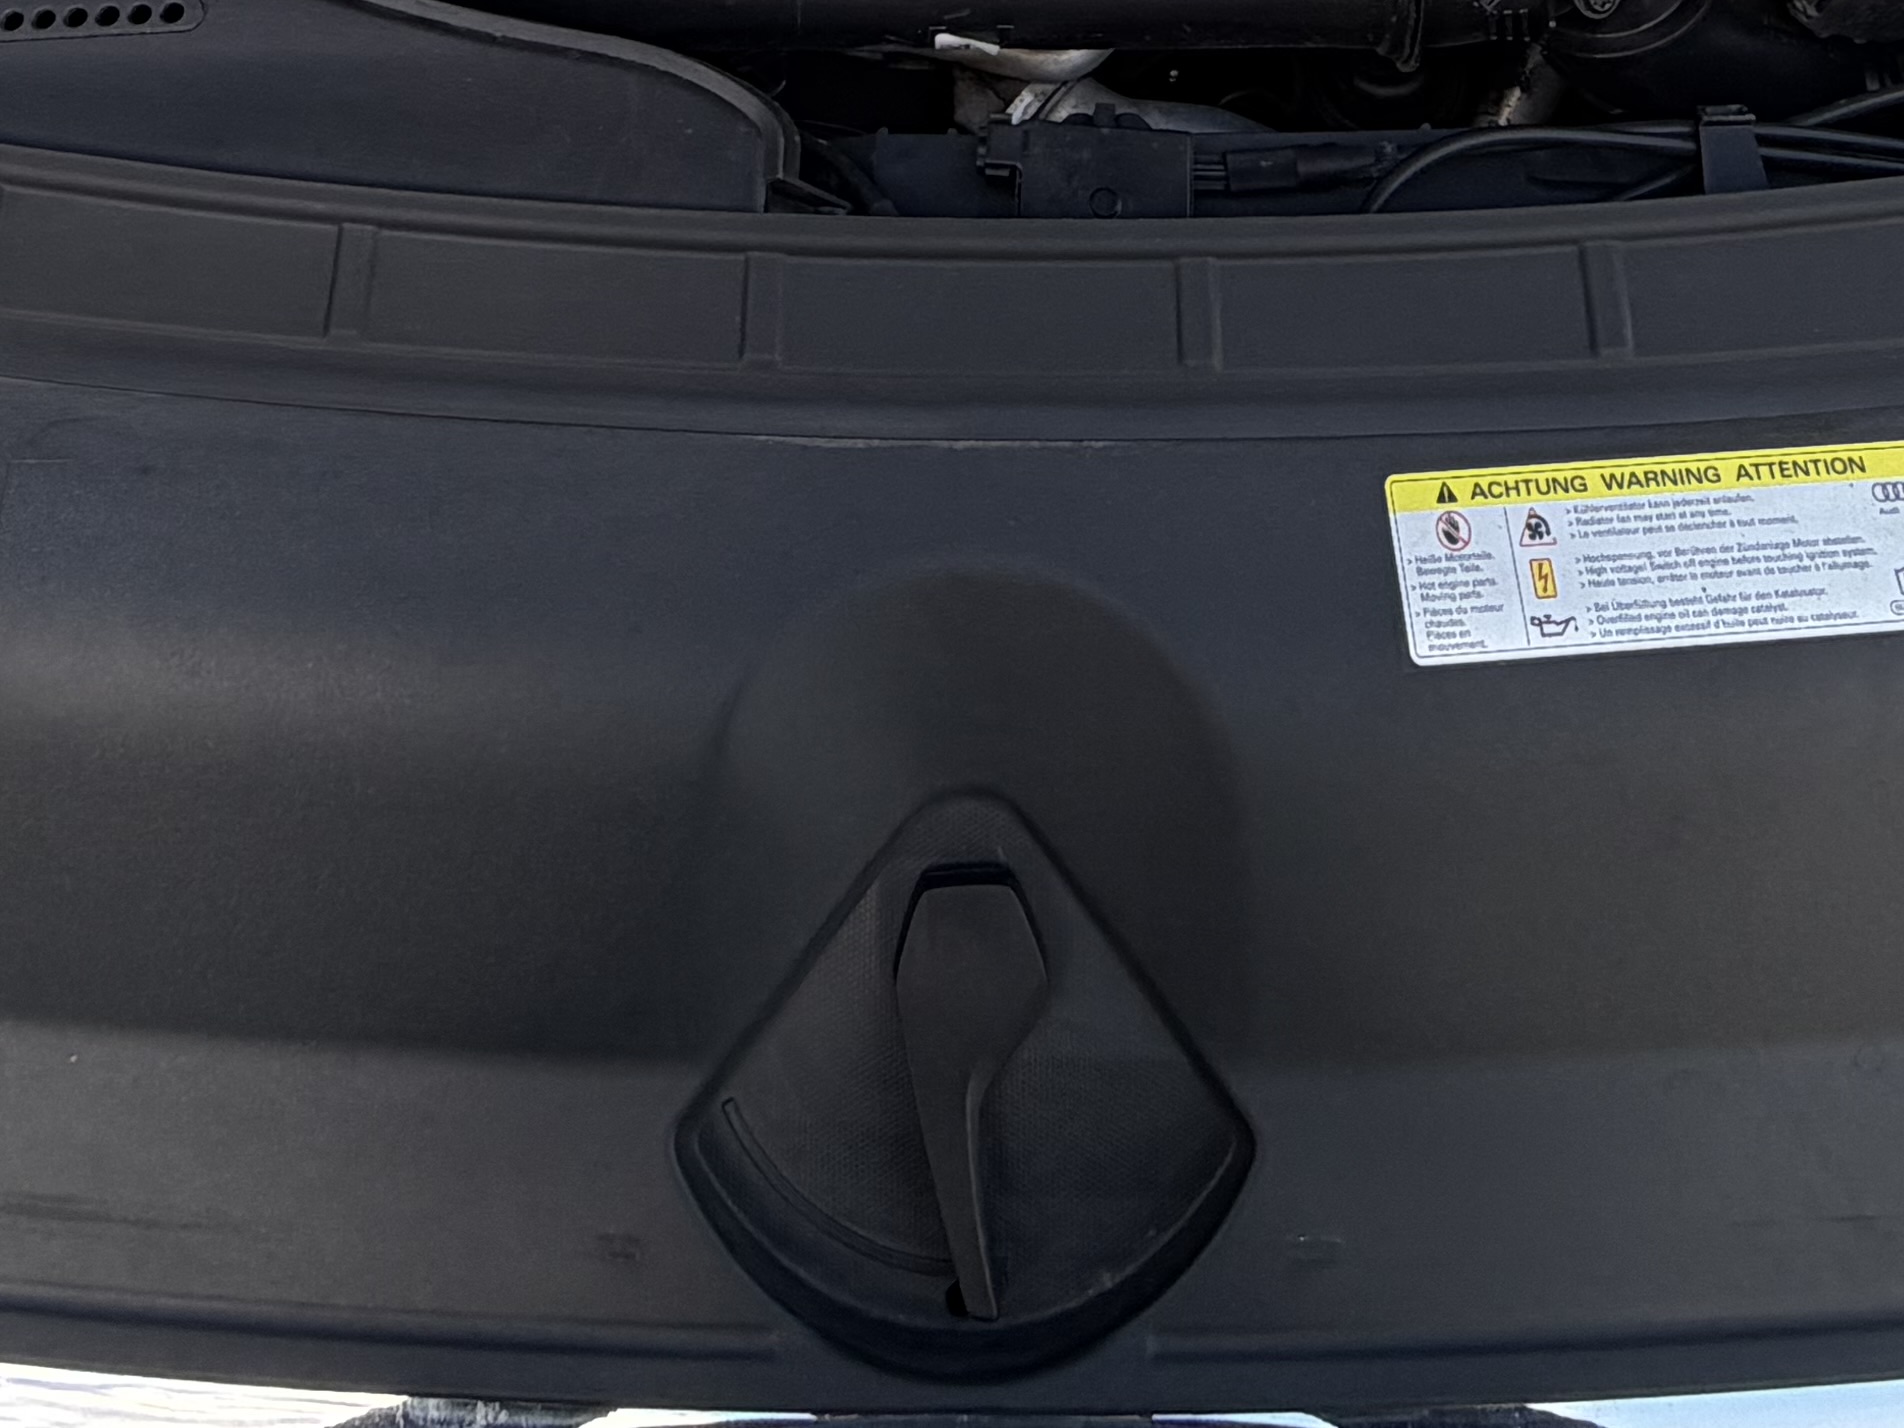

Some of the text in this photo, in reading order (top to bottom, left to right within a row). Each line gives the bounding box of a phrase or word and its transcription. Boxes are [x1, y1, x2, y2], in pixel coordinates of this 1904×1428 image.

[1470, 456, 1867, 500] ACHTUNG WARNING ATTENTION
